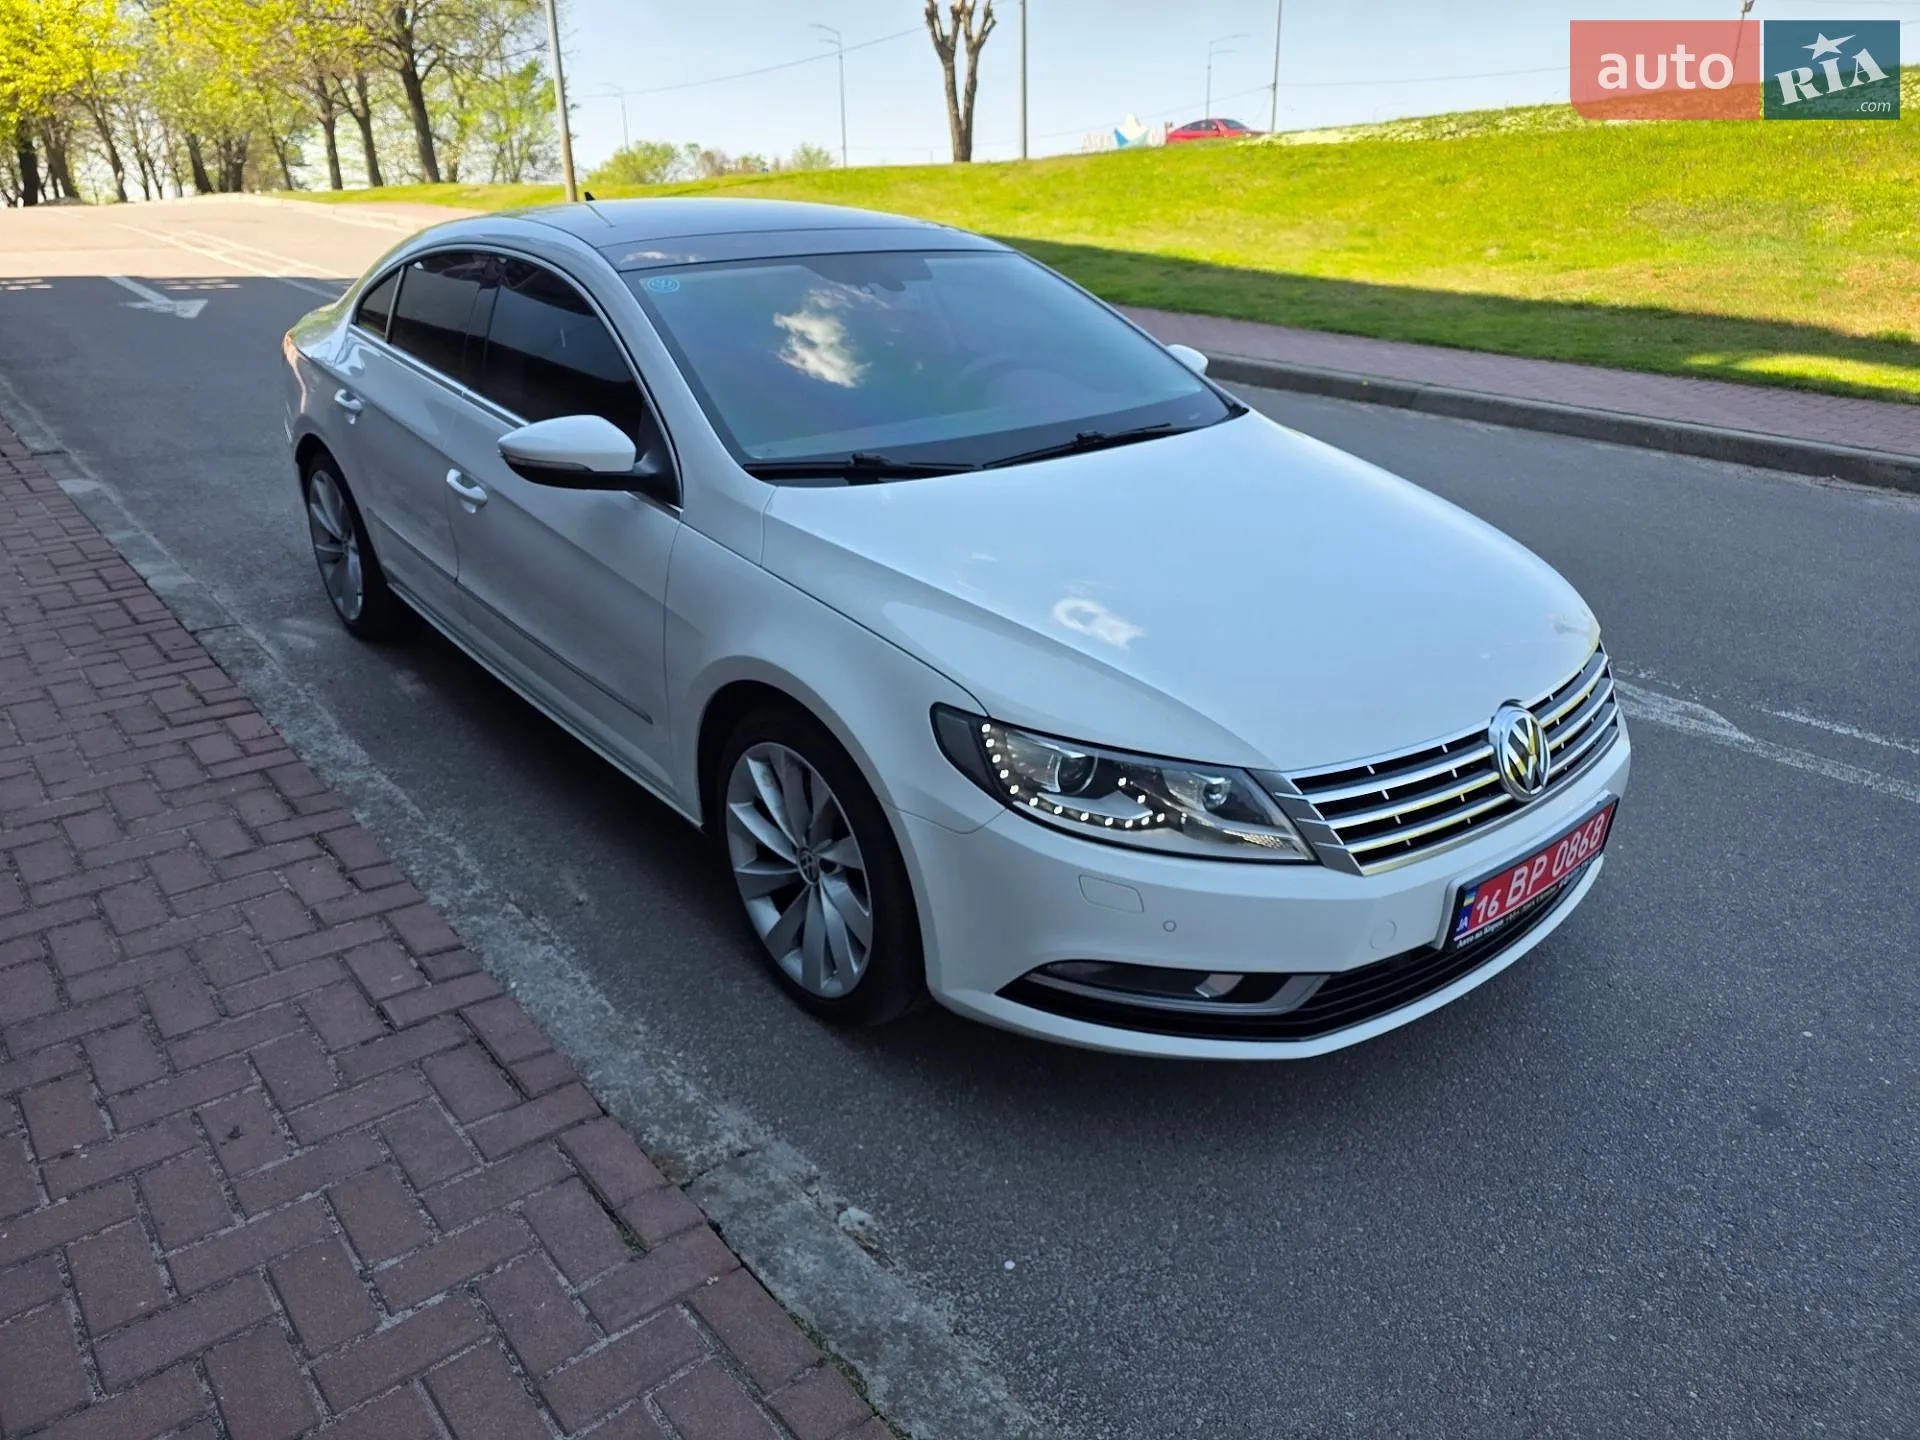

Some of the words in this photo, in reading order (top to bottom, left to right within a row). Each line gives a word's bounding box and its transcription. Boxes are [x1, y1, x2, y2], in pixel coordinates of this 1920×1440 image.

[1476, 888, 1502, 924] 16
[1505, 854, 1548, 908] BP
[1551, 813, 1605, 878] 0868
